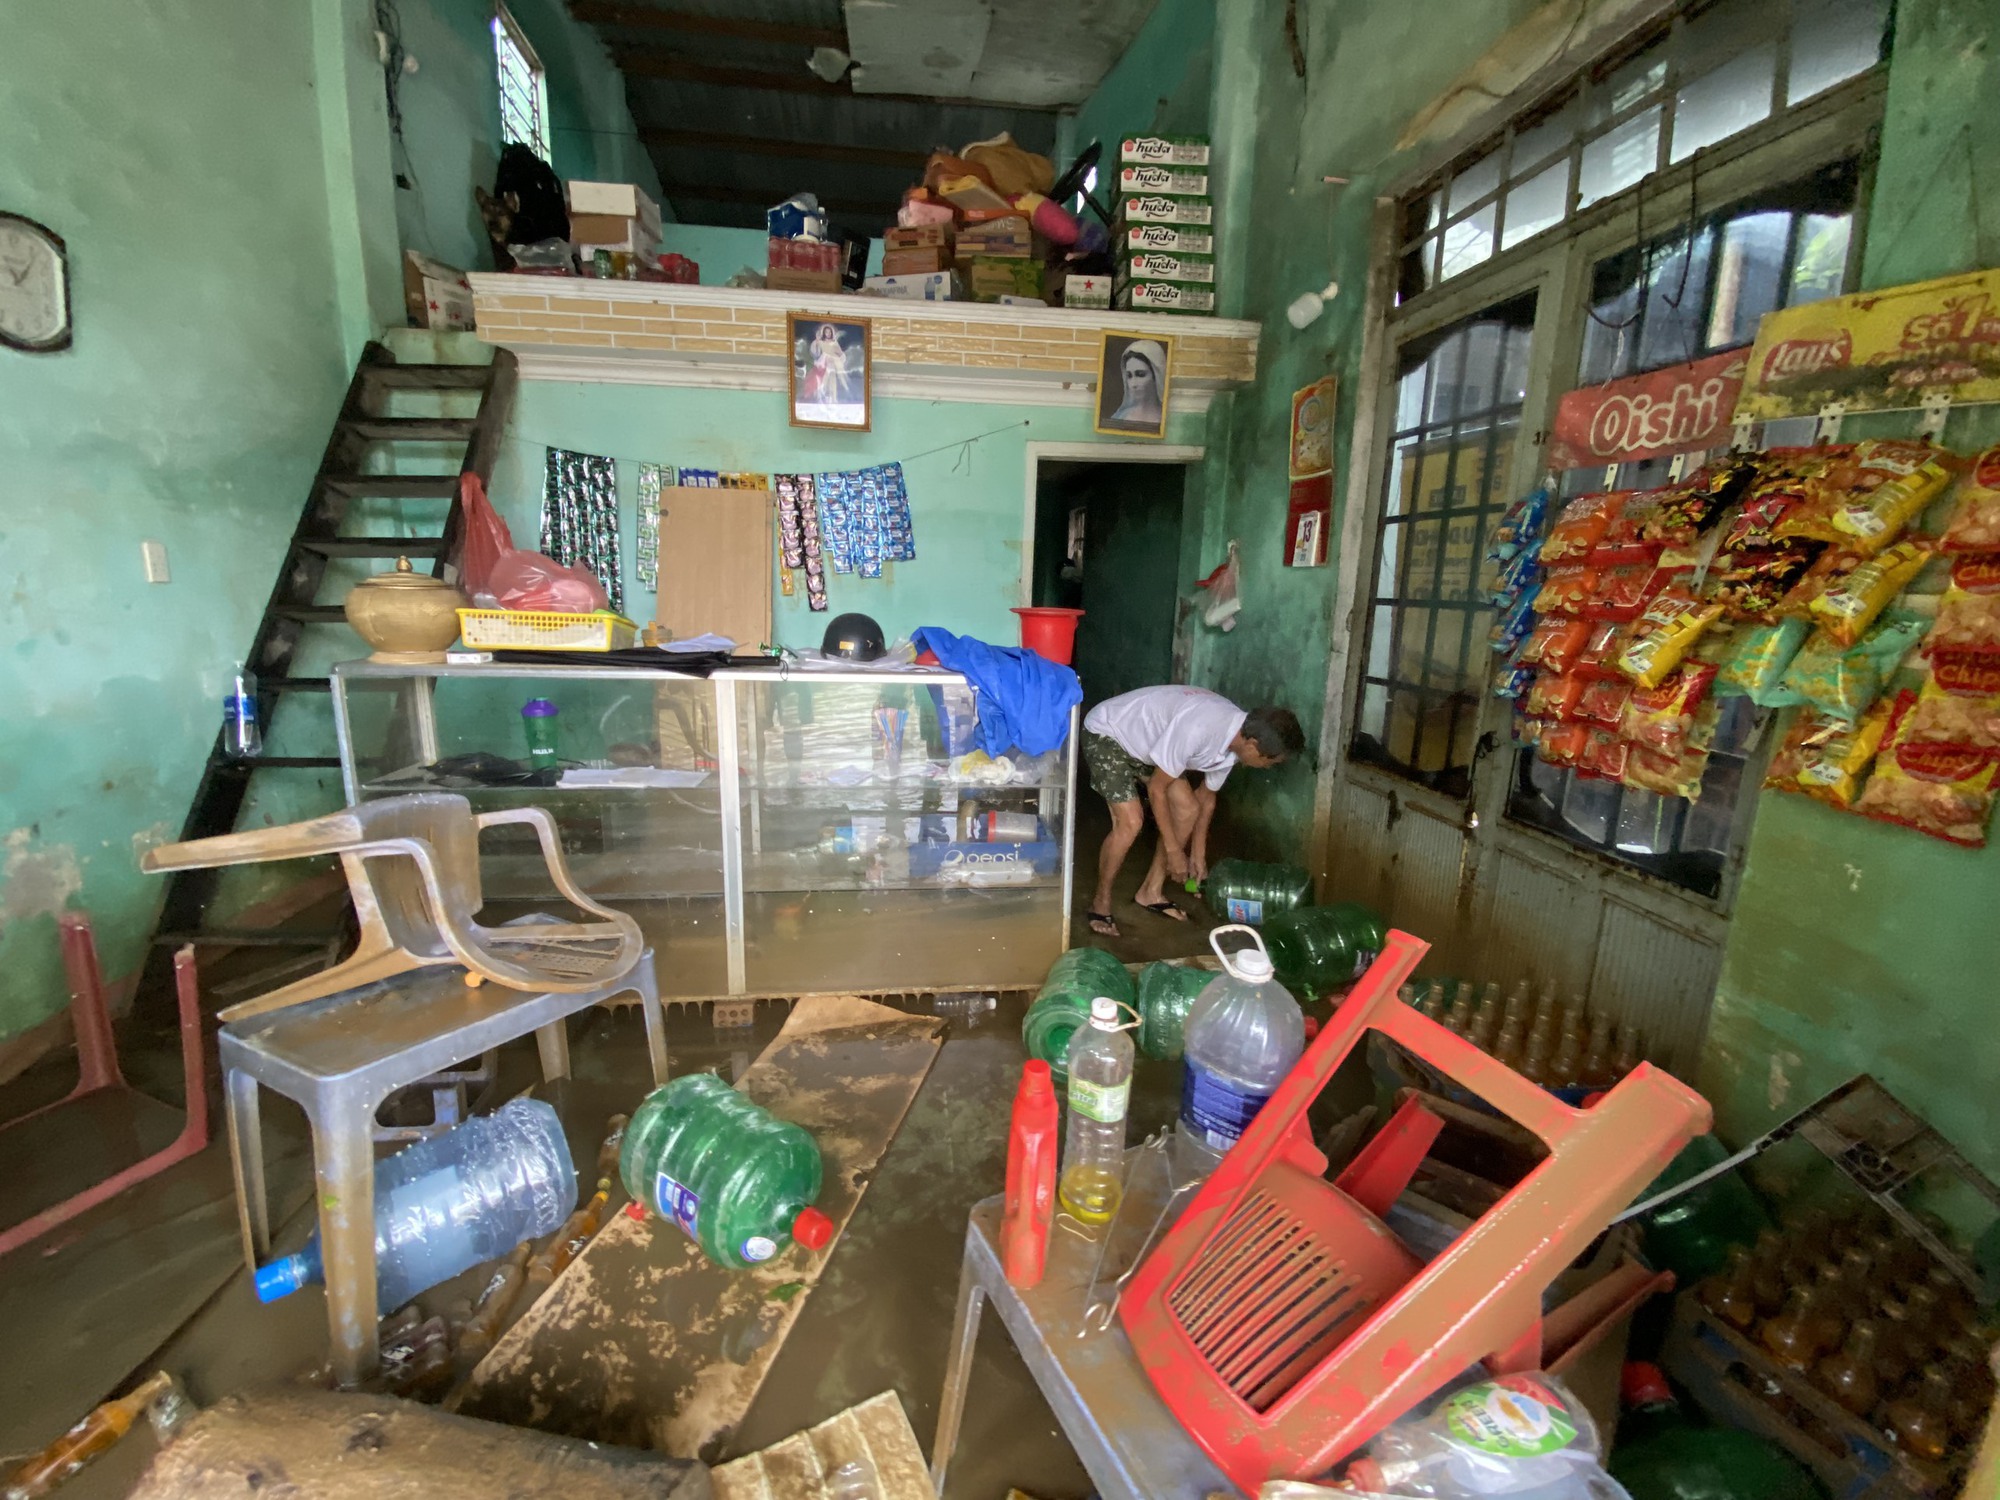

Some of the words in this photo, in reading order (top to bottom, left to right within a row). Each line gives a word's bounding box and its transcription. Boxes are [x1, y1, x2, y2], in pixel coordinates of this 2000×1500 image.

[1136, 140, 1171, 154] huda
[1135, 169, 1170, 183] huda
[1140, 199, 1174, 213] huda
[1142, 228, 1176, 242] huda
[1144, 256, 1178, 270] huda
[1146, 285, 1179, 299] huda
[1590, 377, 1725, 457] Oishi
